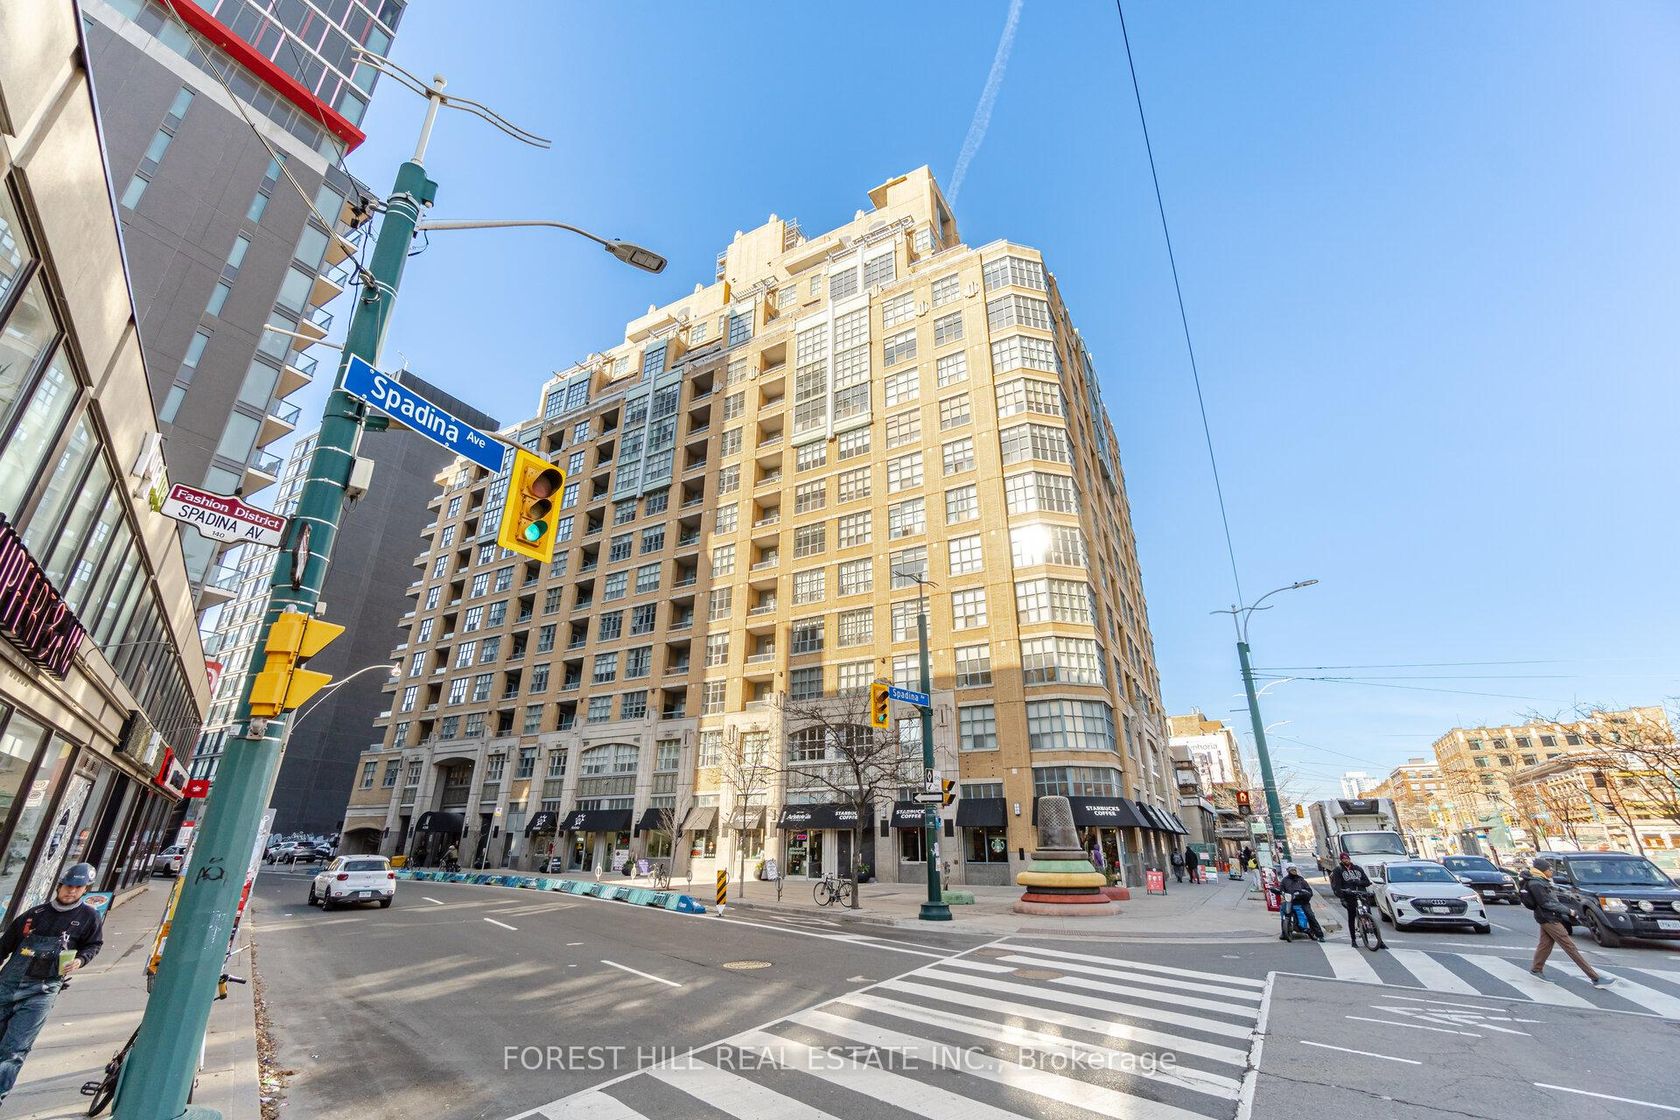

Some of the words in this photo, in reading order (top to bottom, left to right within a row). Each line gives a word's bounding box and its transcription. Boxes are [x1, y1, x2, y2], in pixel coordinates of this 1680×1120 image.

[371, 376, 459, 443] Spadina
[466, 431, 486, 449] Ave
[176, 489, 229, 512] Fashion
[234, 506, 280, 529] District
[178, 505, 237, 533] SPADINA
[212, 530, 225, 538] 140
[892, 689, 919, 702] Spadina
